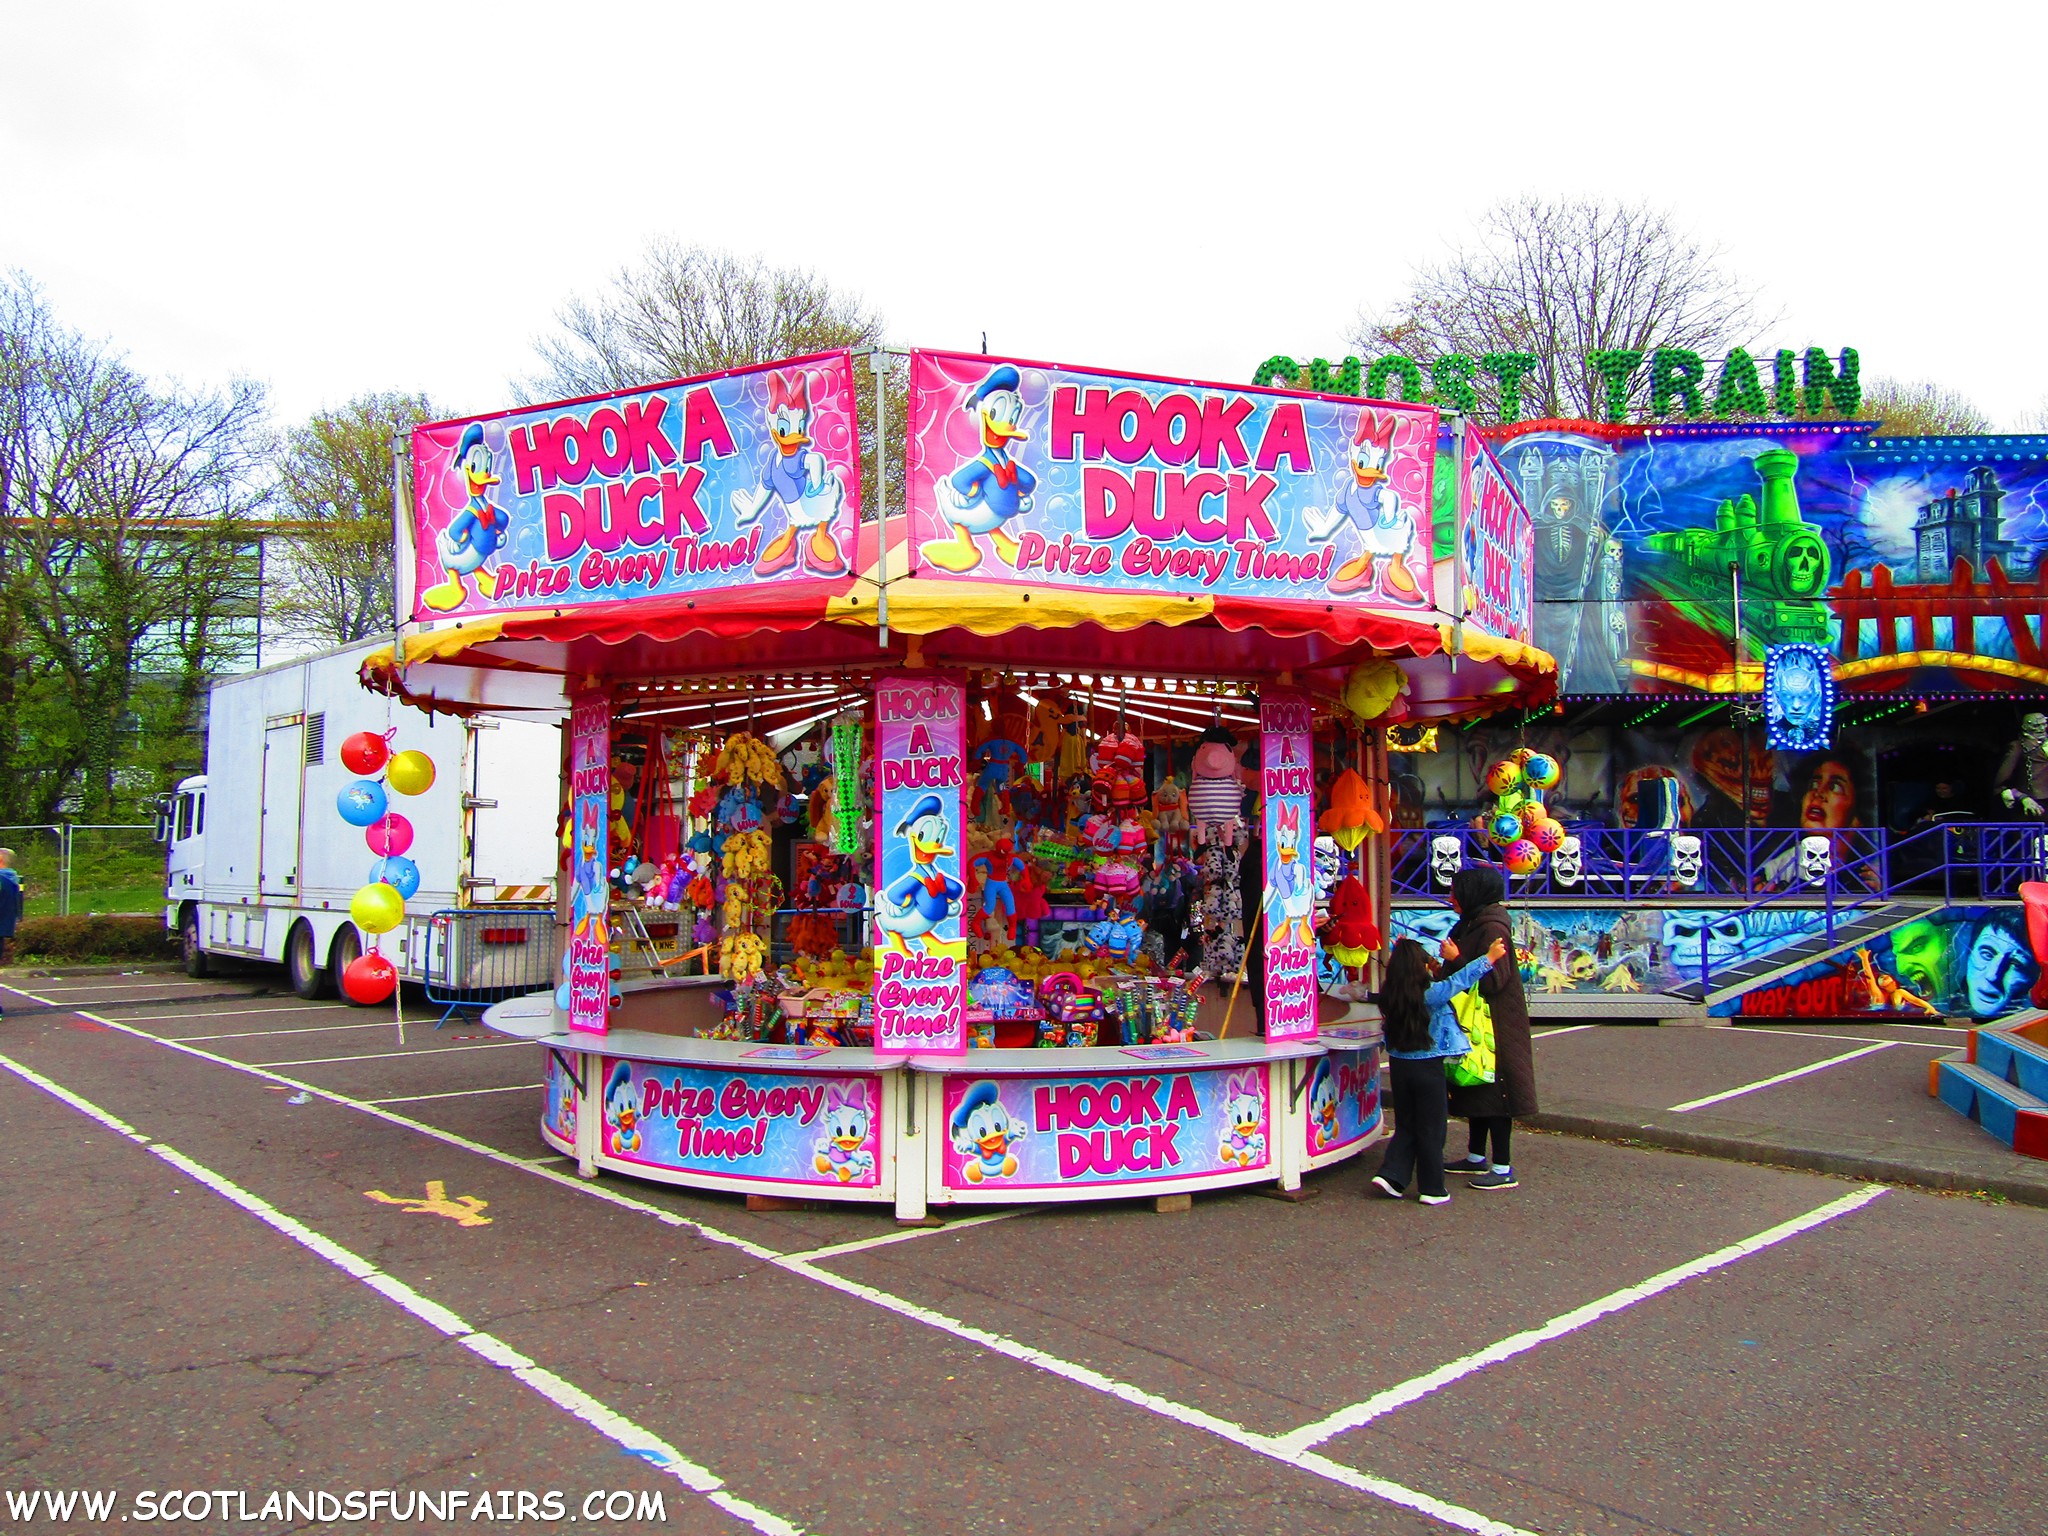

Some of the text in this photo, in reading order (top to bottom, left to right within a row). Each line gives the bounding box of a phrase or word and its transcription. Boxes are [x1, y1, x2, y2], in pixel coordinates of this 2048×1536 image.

[1586, 346, 1863, 422] TRAIN
[509, 386, 737, 495] HOOK A
[1052, 386, 1315, 474] HOOK A
[544, 468, 711, 561] DUCK
[1084, 466, 1280, 544] DUCK
[1480, 470, 1512, 541] HOOK
[493, 526, 762, 601] Prize Every Time!
[1016, 533, 1335, 587] Prize Every Time!
[1483, 537, 1512, 609] DUCK
[575, 702, 608, 737] HOOK
[879, 686, 959, 721] HOOK
[1261, 703, 1309, 734] HOOK
[586, 737, 597, 765] A
[908, 724, 934, 755] A
[1280, 736, 1295, 765] A
[575, 764, 608, 798] DUCK
[883, 756, 963, 790] DUCK
[1266, 767, 1312, 798] DUCK
[1747, 911, 1797, 937] WAY
[573, 938, 604, 967] Prize
[882, 951, 955, 983] Prize
[1269, 946, 1310, 974] Prize
[572, 965, 606, 996] Every
[879, 980, 961, 1012] Every
[1267, 972, 1313, 1000] Every
[1743, 976, 1843, 1016] WAY OUT
[572, 989, 606, 1019] Time!
[1268, 996, 1313, 1027] Time!
[881, 1006, 959, 1039] Time!
[642, 1078, 825, 1126] Prize Every
[1034, 1075, 1201, 1133] HOOK A
[676, 1117, 768, 1161] Time!
[1058, 1123, 1182, 1178] DUCK
